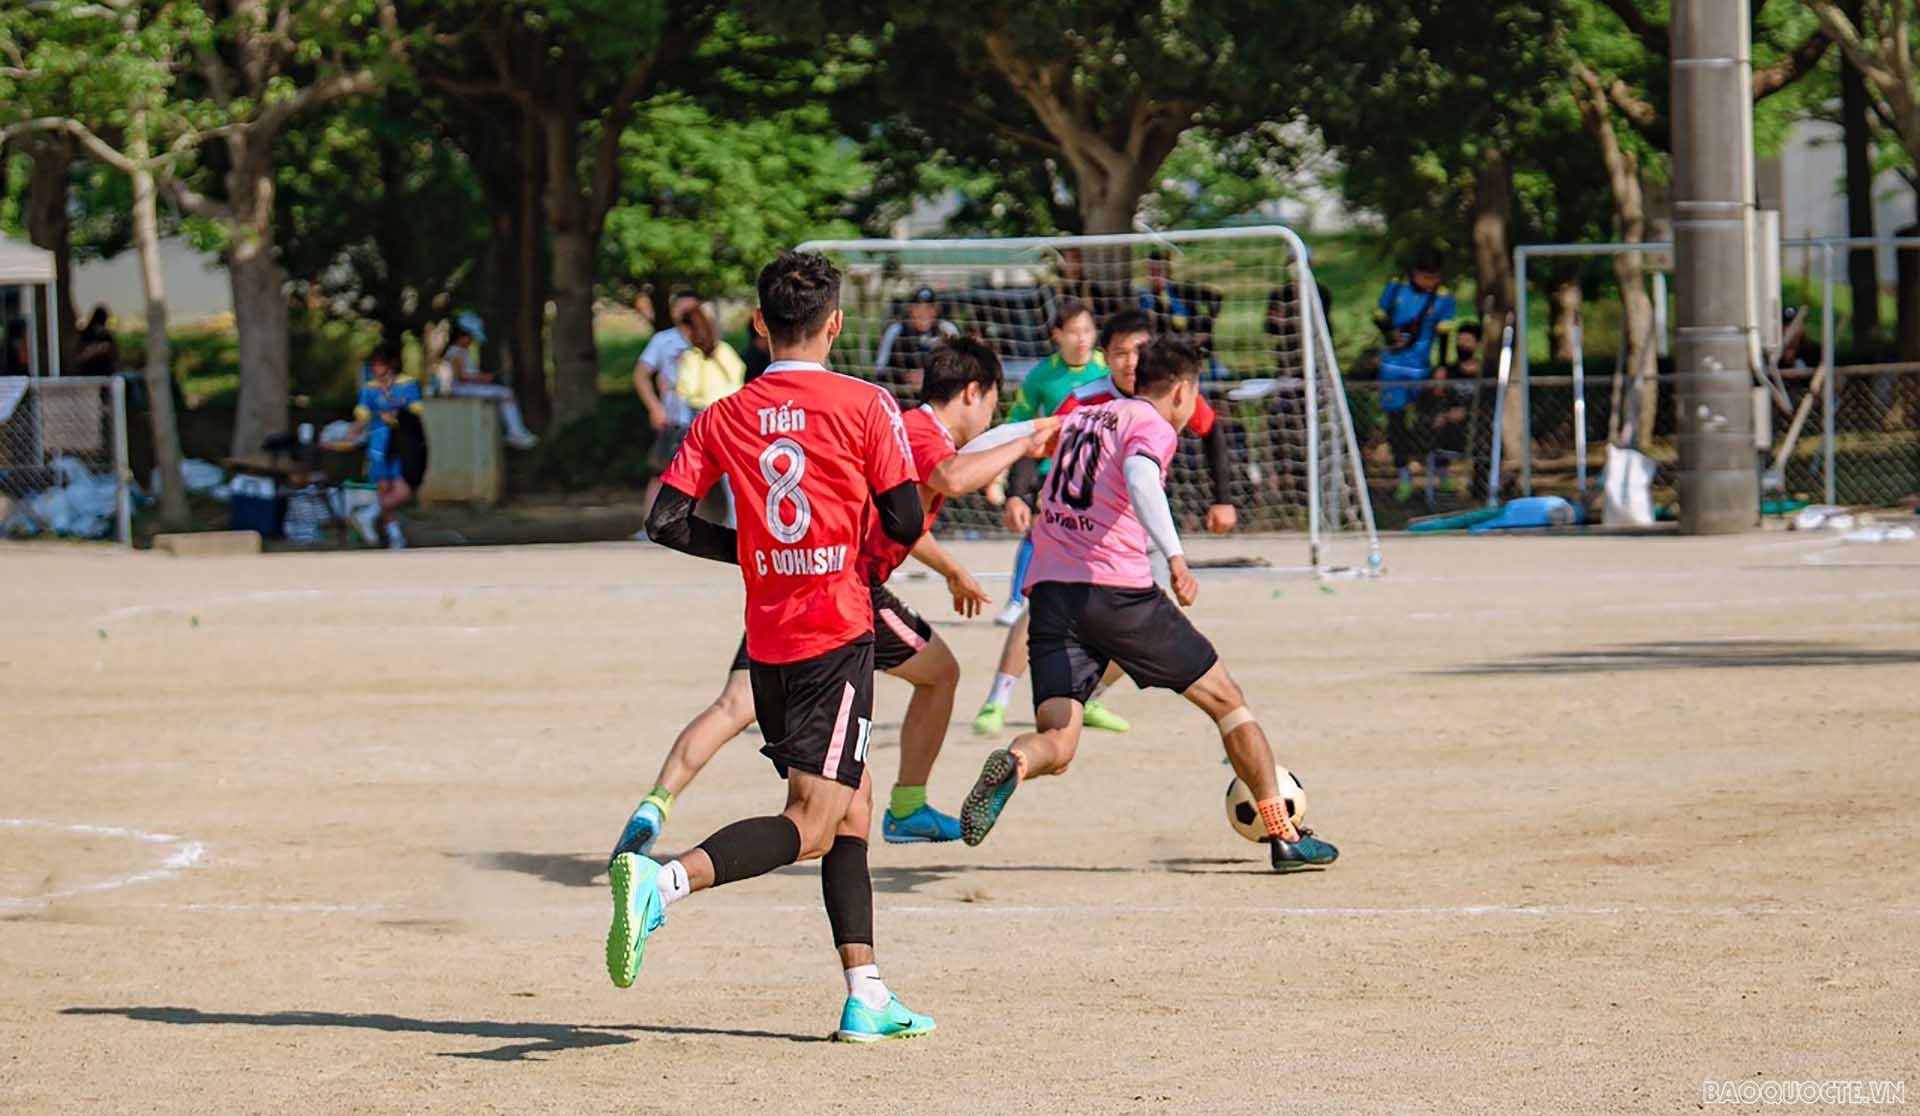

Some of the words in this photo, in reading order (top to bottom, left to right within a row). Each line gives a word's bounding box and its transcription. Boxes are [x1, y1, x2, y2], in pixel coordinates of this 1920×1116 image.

[757, 400, 806, 435] Tiến
[759, 438, 811, 544] 8
[1048, 424, 1100, 511] 10
[755, 549, 768, 576] C
